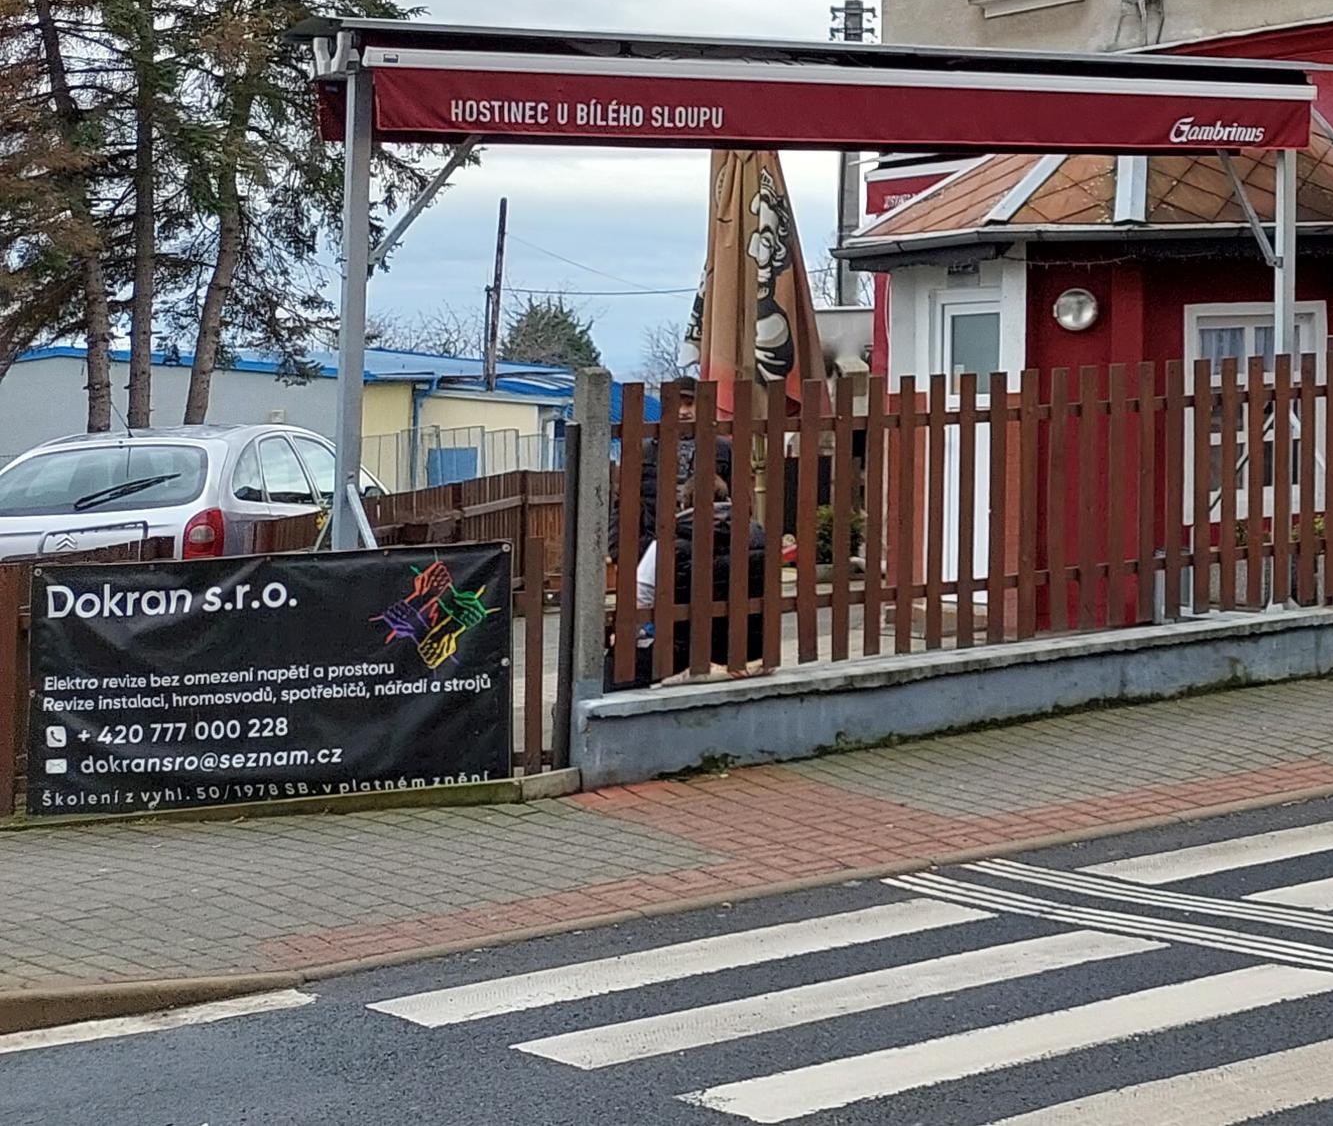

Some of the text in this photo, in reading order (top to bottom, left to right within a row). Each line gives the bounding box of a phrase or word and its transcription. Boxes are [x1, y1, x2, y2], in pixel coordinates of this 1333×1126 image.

[451, 99, 723, 129] HOSTINEC U BÍLÉHO SLOUPU
[1169, 117, 1265, 143] Gambrinus
[46, 581, 298, 619] Dokran s.r.o.
[44, 662, 395, 691] Elektro revize bez omezení napětí a prostoru
[42, 695, 95, 712] Revize
[172, 685, 277, 708] hromosvodů,
[281, 682, 370, 703] spotřebičů,
[374, 678, 427, 696] nářadí
[430, 681, 441, 692] a
[444, 673, 492, 693] strojů
[77, 717, 288, 744] + 420 777 000 228
[80, 747, 343, 774] dokransro@seznam.cz
[42, 770, 490, 808] Školení z vyhl. 50/1978 SB. v platném znění
